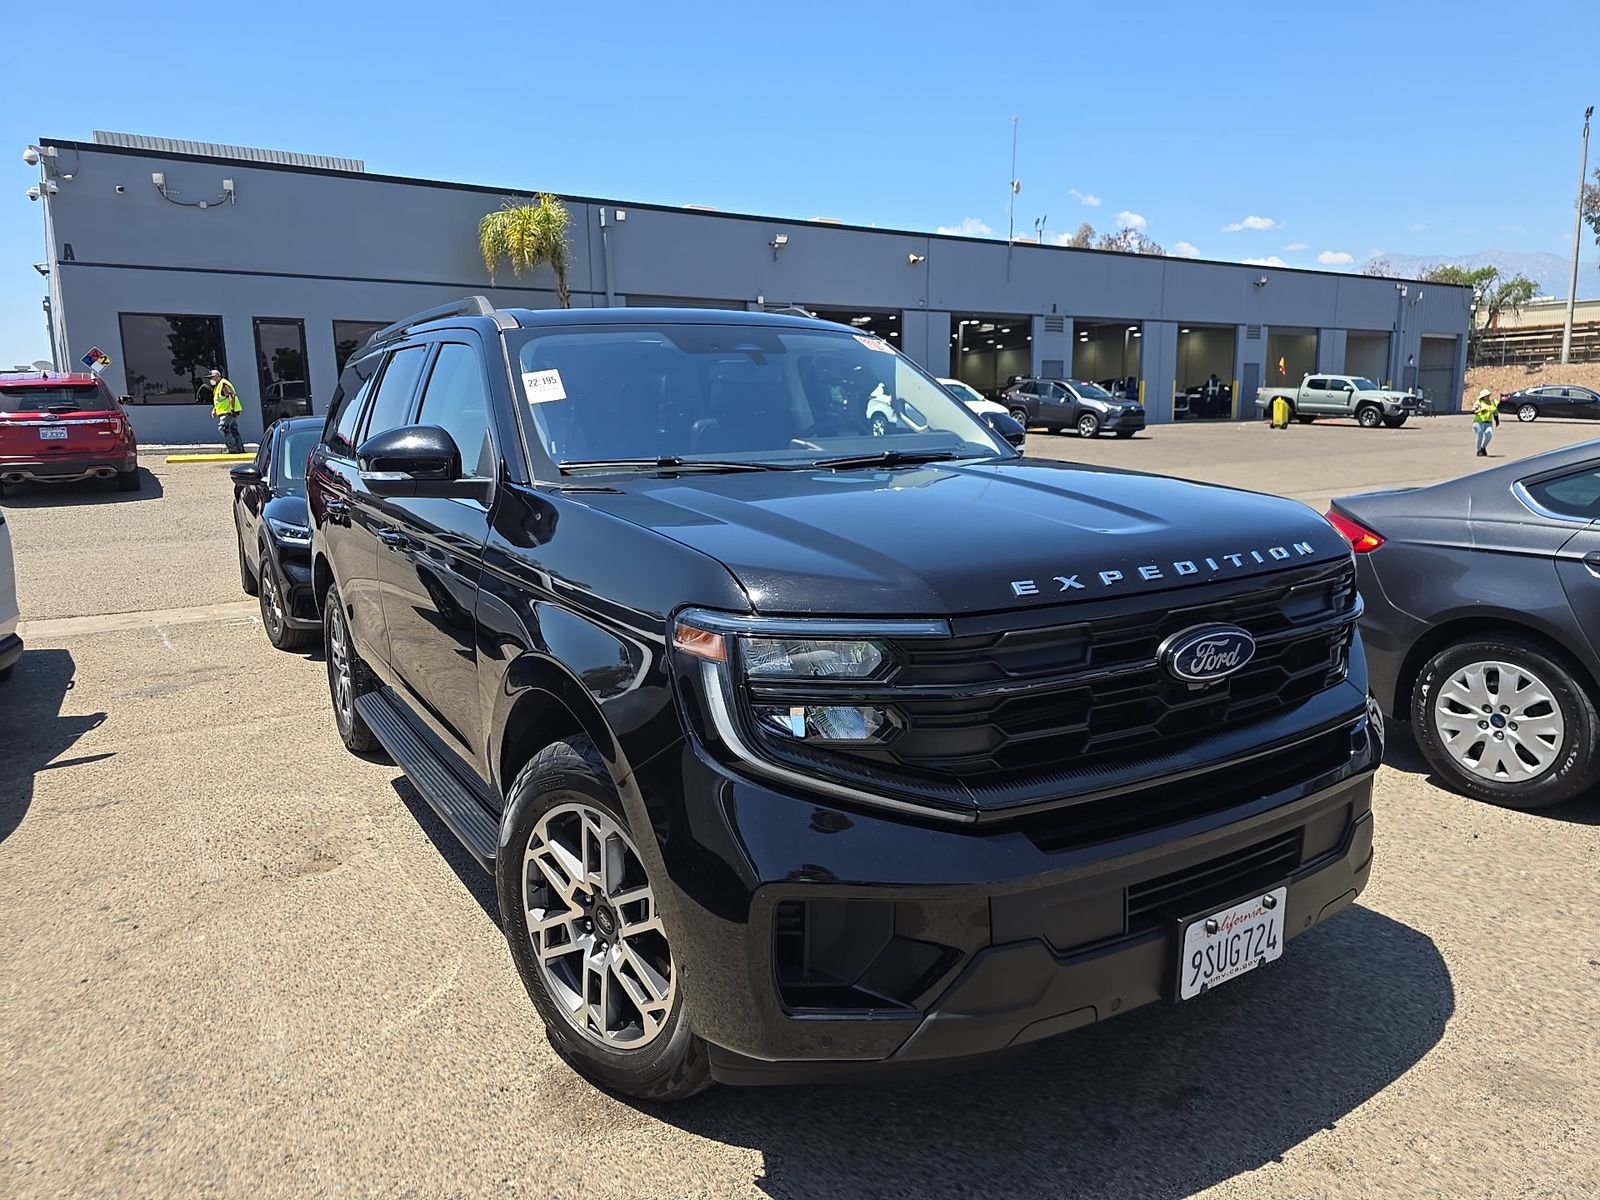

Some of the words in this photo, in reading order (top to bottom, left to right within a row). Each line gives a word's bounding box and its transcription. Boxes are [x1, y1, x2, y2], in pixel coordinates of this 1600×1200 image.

[63, 243, 75, 260] A
[1010, 541, 1315, 598] EXPEDITION
[1190, 638, 1242, 674] Ford
[1206, 904, 1267, 938] lifornia
[1190, 918, 1277, 987] 9SUG724
